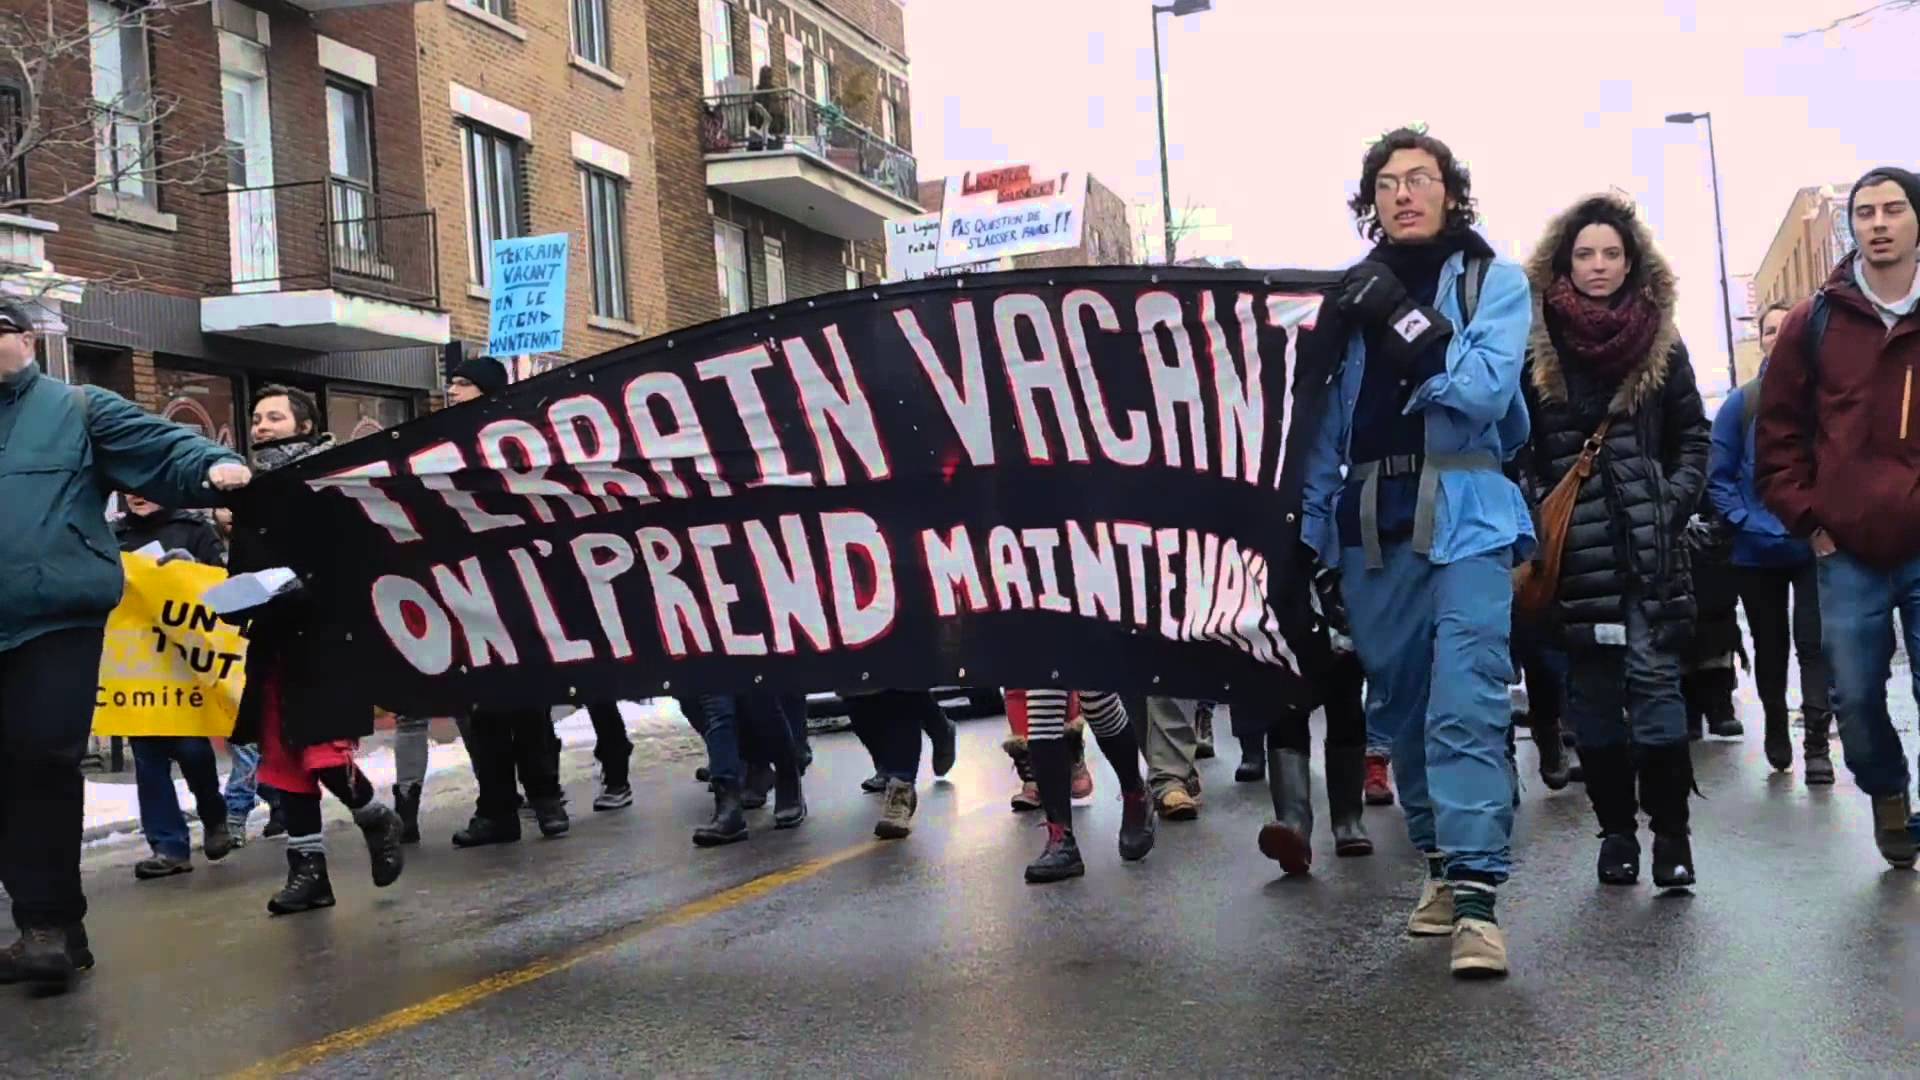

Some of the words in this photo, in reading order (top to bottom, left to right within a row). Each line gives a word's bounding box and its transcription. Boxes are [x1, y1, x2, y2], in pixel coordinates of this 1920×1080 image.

[952, 218, 970, 237] PAS
[975, 215, 1023, 233] QUESTION
[1027, 211, 1041, 222] DE
[496, 243, 566, 265] TERRAIN
[495, 292, 514, 312] ON
[526, 291, 546, 306] LE
[498, 311, 551, 331] PREND
[306, 322, 891, 544] TERRAIN
[893, 288, 1324, 490] VACANT
[161, 600, 218, 632] UN
[371, 555, 520, 676] ON
